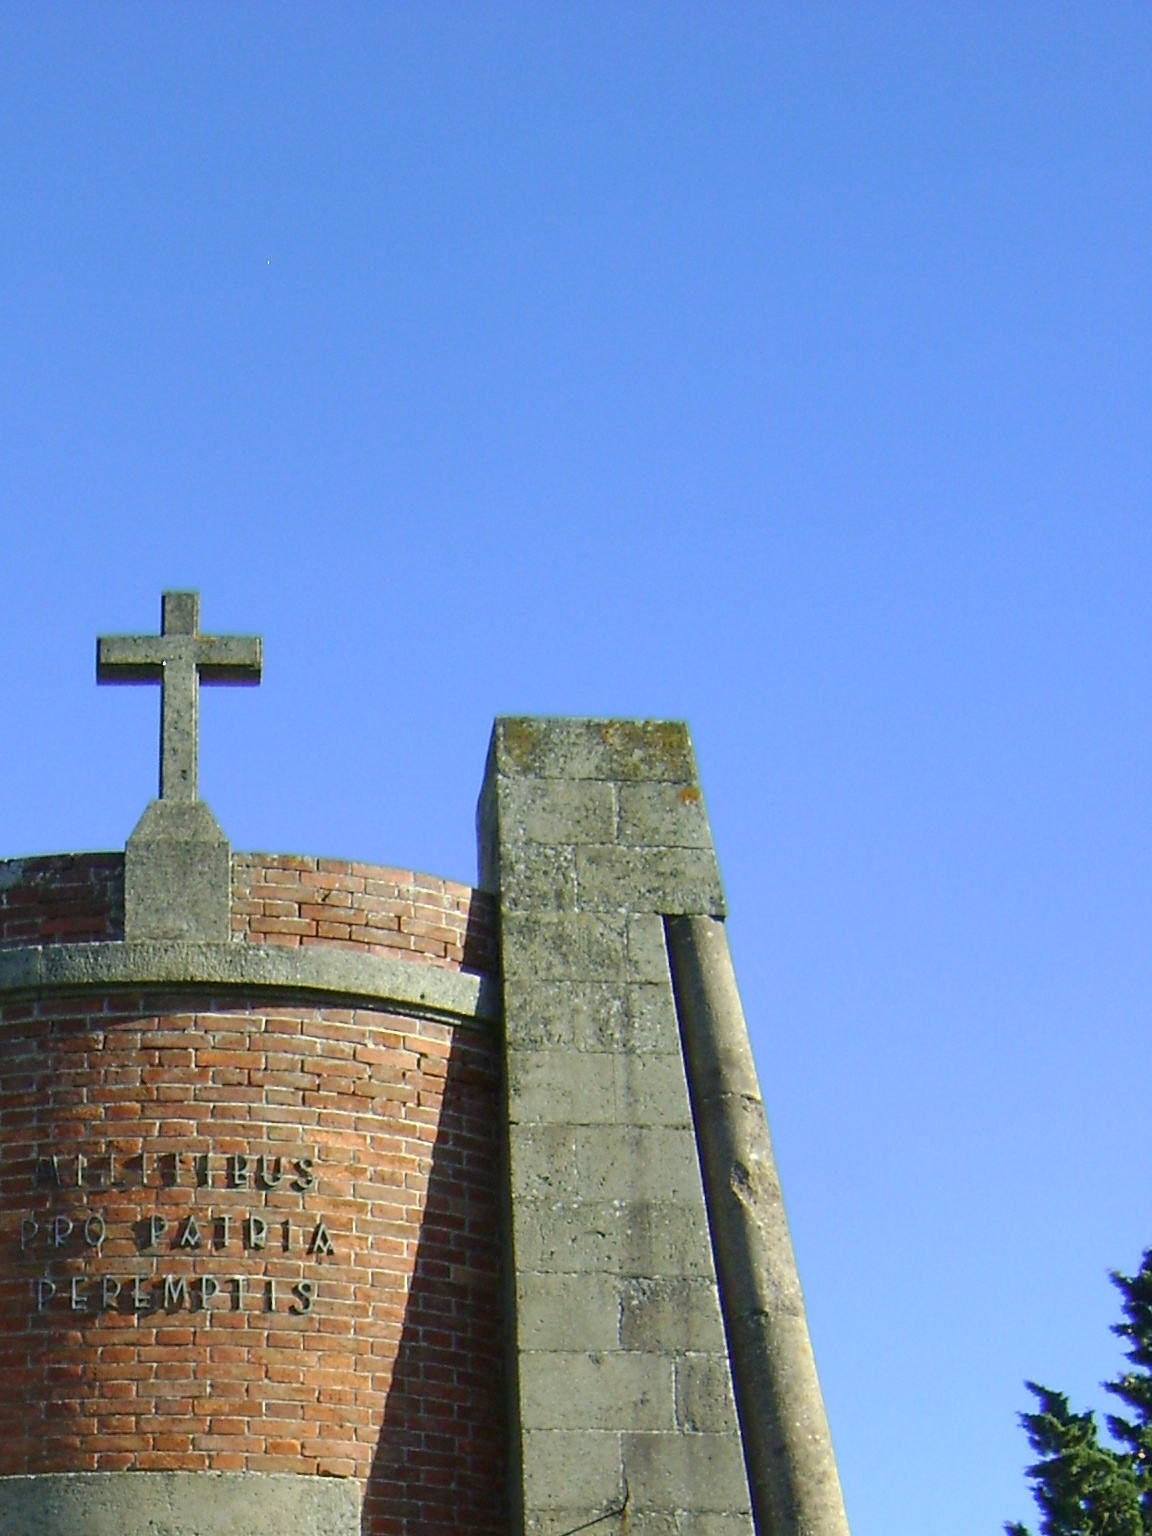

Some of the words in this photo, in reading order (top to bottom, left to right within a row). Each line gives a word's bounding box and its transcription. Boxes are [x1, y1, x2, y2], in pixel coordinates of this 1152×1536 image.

[20, 1213, 107, 1250] PRO
[149, 1213, 335, 1256] PATRIA
[37, 1274, 315, 1314] PEREMPTIS
